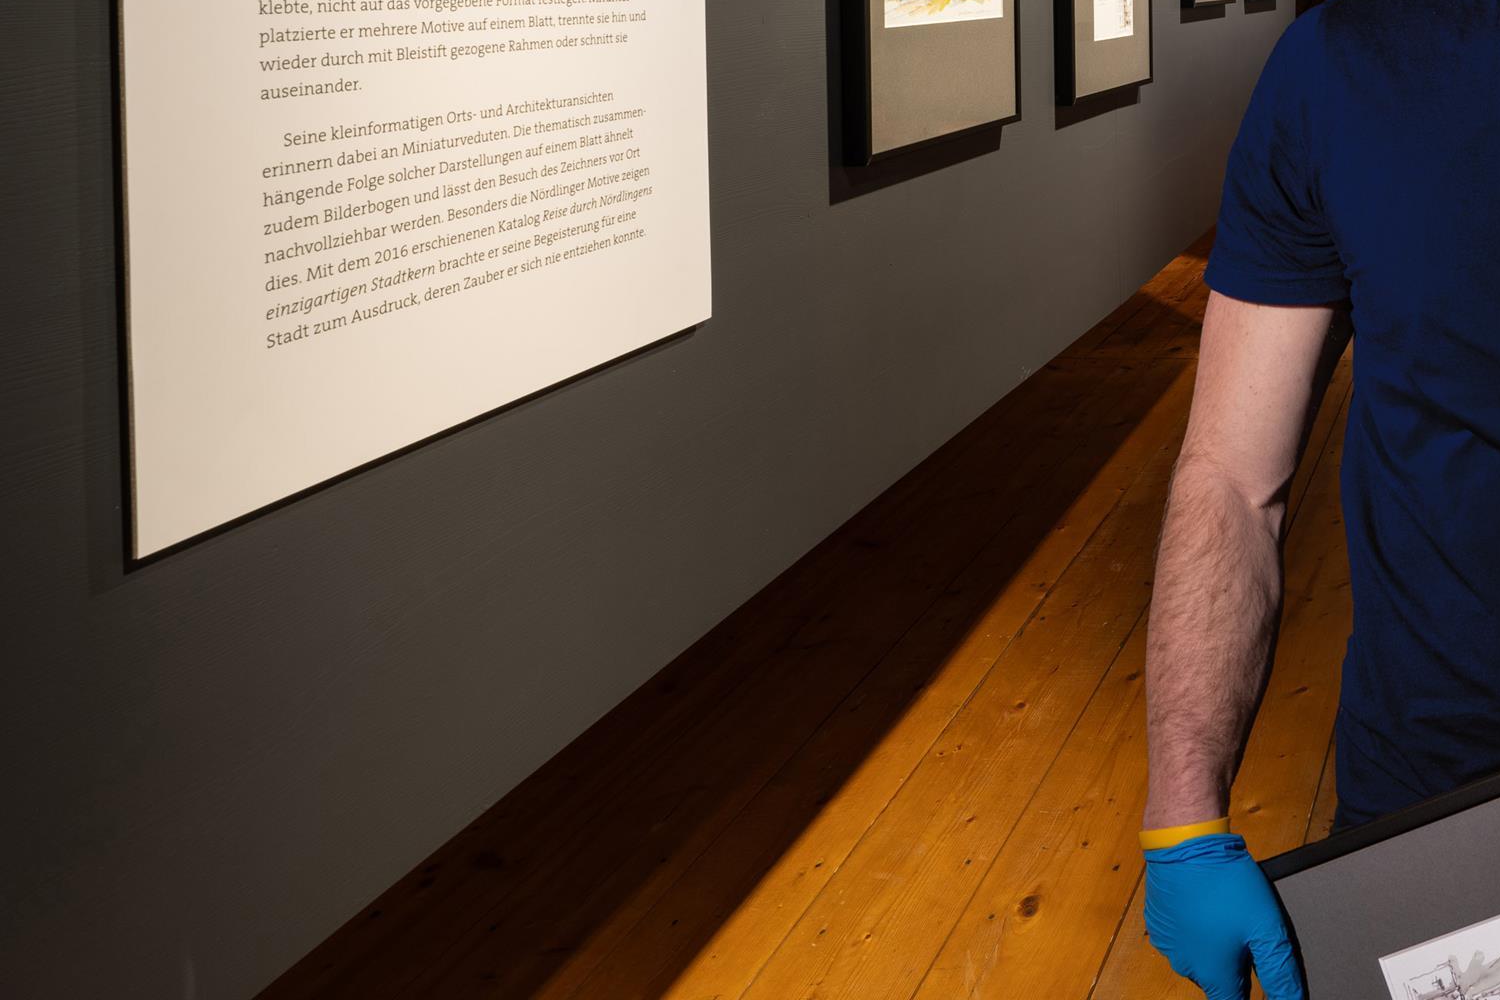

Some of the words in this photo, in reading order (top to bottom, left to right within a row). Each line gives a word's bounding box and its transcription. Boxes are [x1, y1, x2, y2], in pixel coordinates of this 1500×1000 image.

[258, 0, 313, 15] klebte,
[258, 26, 336, 48] platzierte
[339, 27, 355, 39] er
[358, 22, 418, 38] mehrere
[420, 19, 465, 35] Motive
[467, 17, 489, 32] auf
[489, 17, 526, 30] einem
[259, 53, 318, 72] wieder
[320, 49, 365, 67] durch
[367, 48, 393, 64] mit
[396, 44, 448, 61] Bleistift
[450, 43, 506, 61] gezogene
[507, 38, 554, 52] Rahmen
[260, 77, 362, 101] auseinander.
[283, 130, 327, 148] Seine
[330, 115, 444, 141] kleinformatigen
[446, 109, 477, 124] Orts-
[479, 103, 504, 120] und
[505, 91, 614, 116] Architekturansichten
[262, 157, 334, 179] erinnern
[336, 147, 378, 167] dabei
[380, 147, 399, 160] an
[401, 129, 511, 156] Miniaturveduten.
[512, 124, 532, 138] Die
[262, 180, 344, 208] hängende
[346, 174, 385, 192] Folge
[388, 165, 436, 184] solcher
[438, 150, 523, 175] Darstellungen
[263, 214, 320, 236] zudem
[323, 195, 411, 224] Bilderbogen
[413, 185, 440, 205] und
[442, 181, 472, 199] lässt
[473, 177, 497, 192] den
[498, 167, 539, 187] Besuch
[264, 225, 388, 264] nachvollziehbar
[390, 213, 444, 235] werden.
[447, 199, 508, 222] Besonders
[510, 193, 528, 207] die
[265, 274, 303, 292] dies.
[306, 263, 335, 282] Mit
[337, 256, 371, 274] dem
[374, 244, 409, 265] 2016
[411, 225, 496, 255] erschienenen
[498, 213, 541, 233] Katalog
[265, 283, 368, 321] einzigartigen
[371, 264, 436, 292] Stadtkern
[438, 250, 486, 273] brachte
[487, 247, 500, 259] er
[501, 239, 532, 256] seine
[266, 324, 310, 350] Stadt
[313, 315, 348, 335] zum
[350, 292, 421, 324] Ausdruck,
[423, 282, 461, 302] deren
[463, 269, 505, 290] Zauber
[506, 265, 519, 277] er
[520, 256, 543, 273] sich
